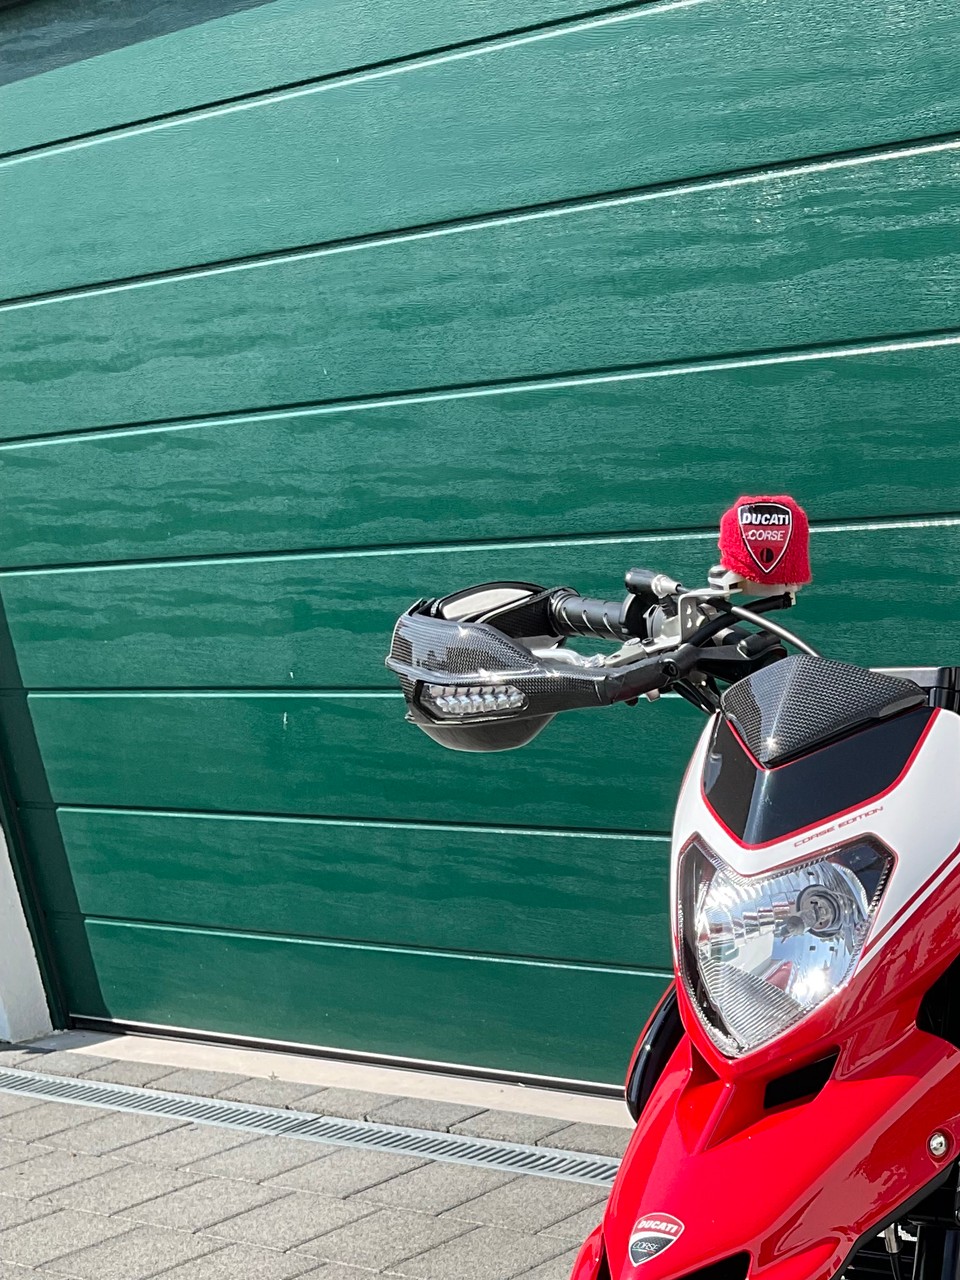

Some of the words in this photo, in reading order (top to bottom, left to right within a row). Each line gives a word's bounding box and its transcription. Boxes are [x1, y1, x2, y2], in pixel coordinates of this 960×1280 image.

[741, 513, 789, 525] DUCATI
[749, 530, 785, 541] CORSE
[793, 826, 836, 848] CORSE
[838, 806, 884, 829] EDITION
[637, 1220, 678, 1233] DUCATI
[633, 1241, 660, 1251] CORSE
